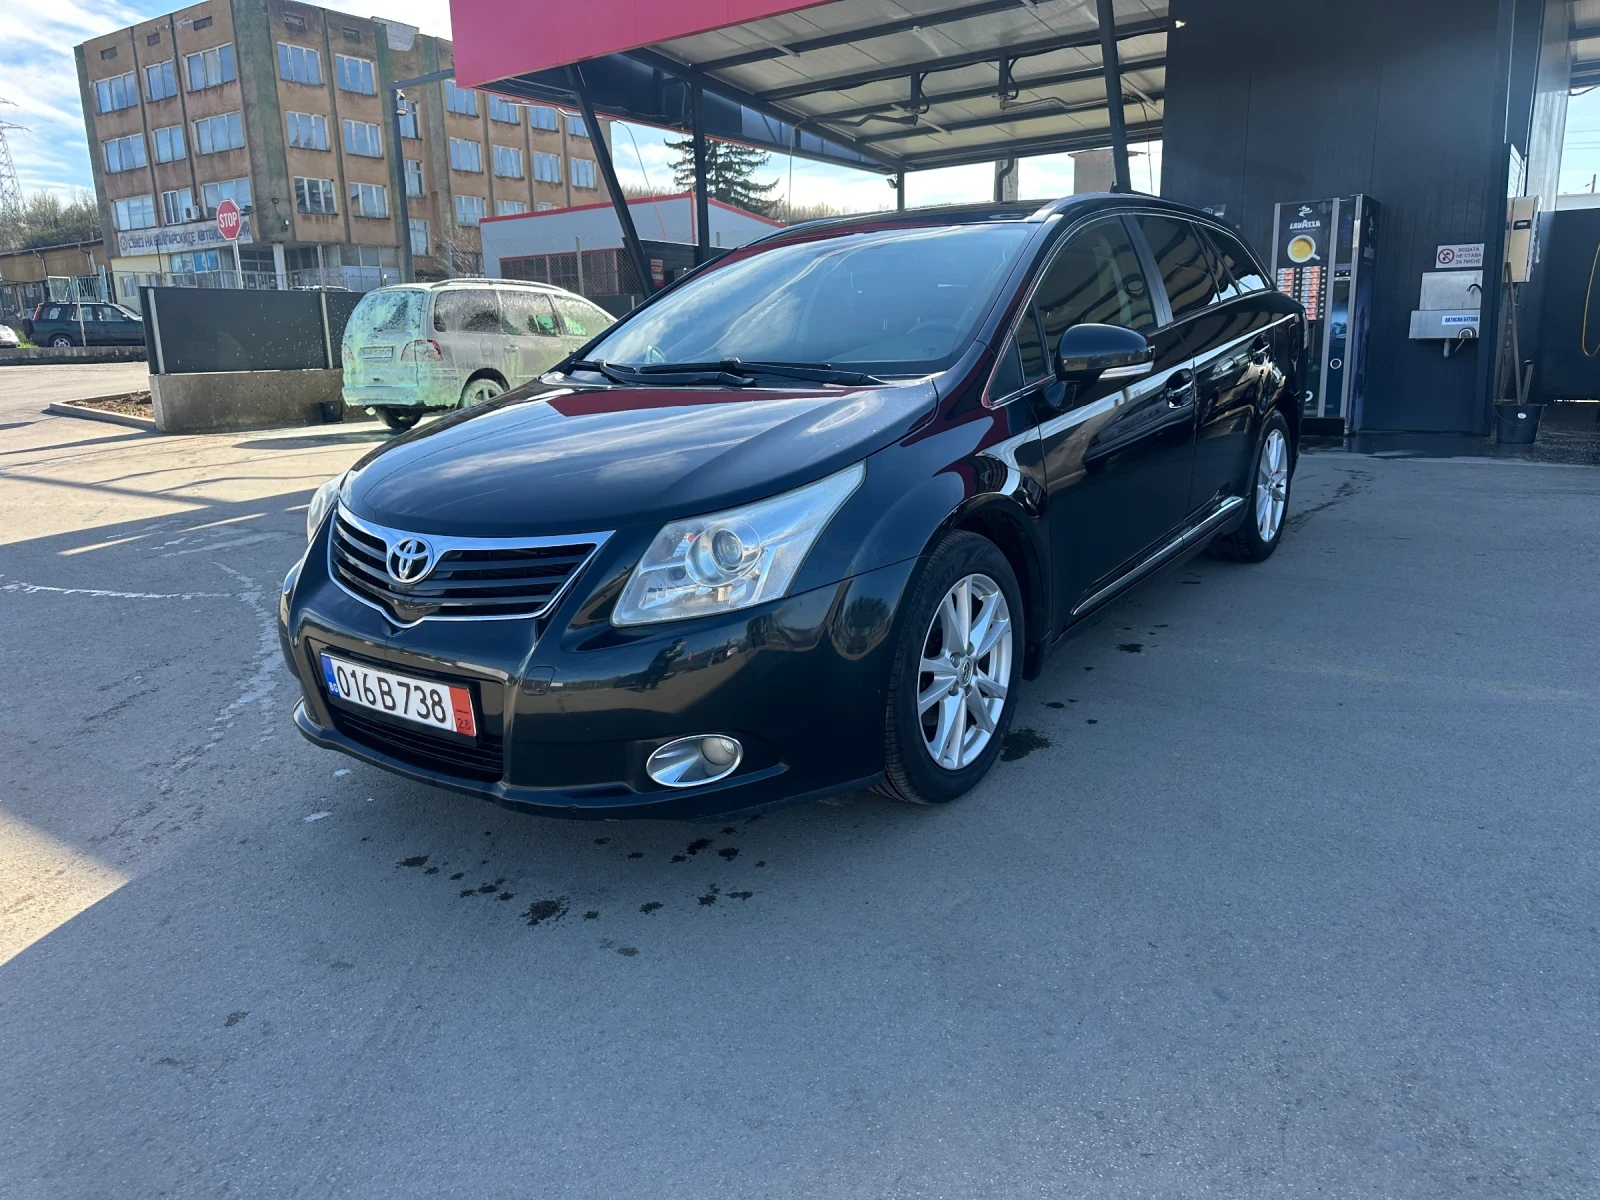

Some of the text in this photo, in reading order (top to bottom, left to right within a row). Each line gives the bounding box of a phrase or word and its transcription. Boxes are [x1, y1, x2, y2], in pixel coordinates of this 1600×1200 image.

[219, 212, 238, 228] STOP
[1289, 220, 1321, 229] LAVAZZA
[145, 237, 153, 246] НА
[329, 682, 339, 693] BG
[337, 665, 447, 723] 016B738
[457, 717, 471, 731] 28
